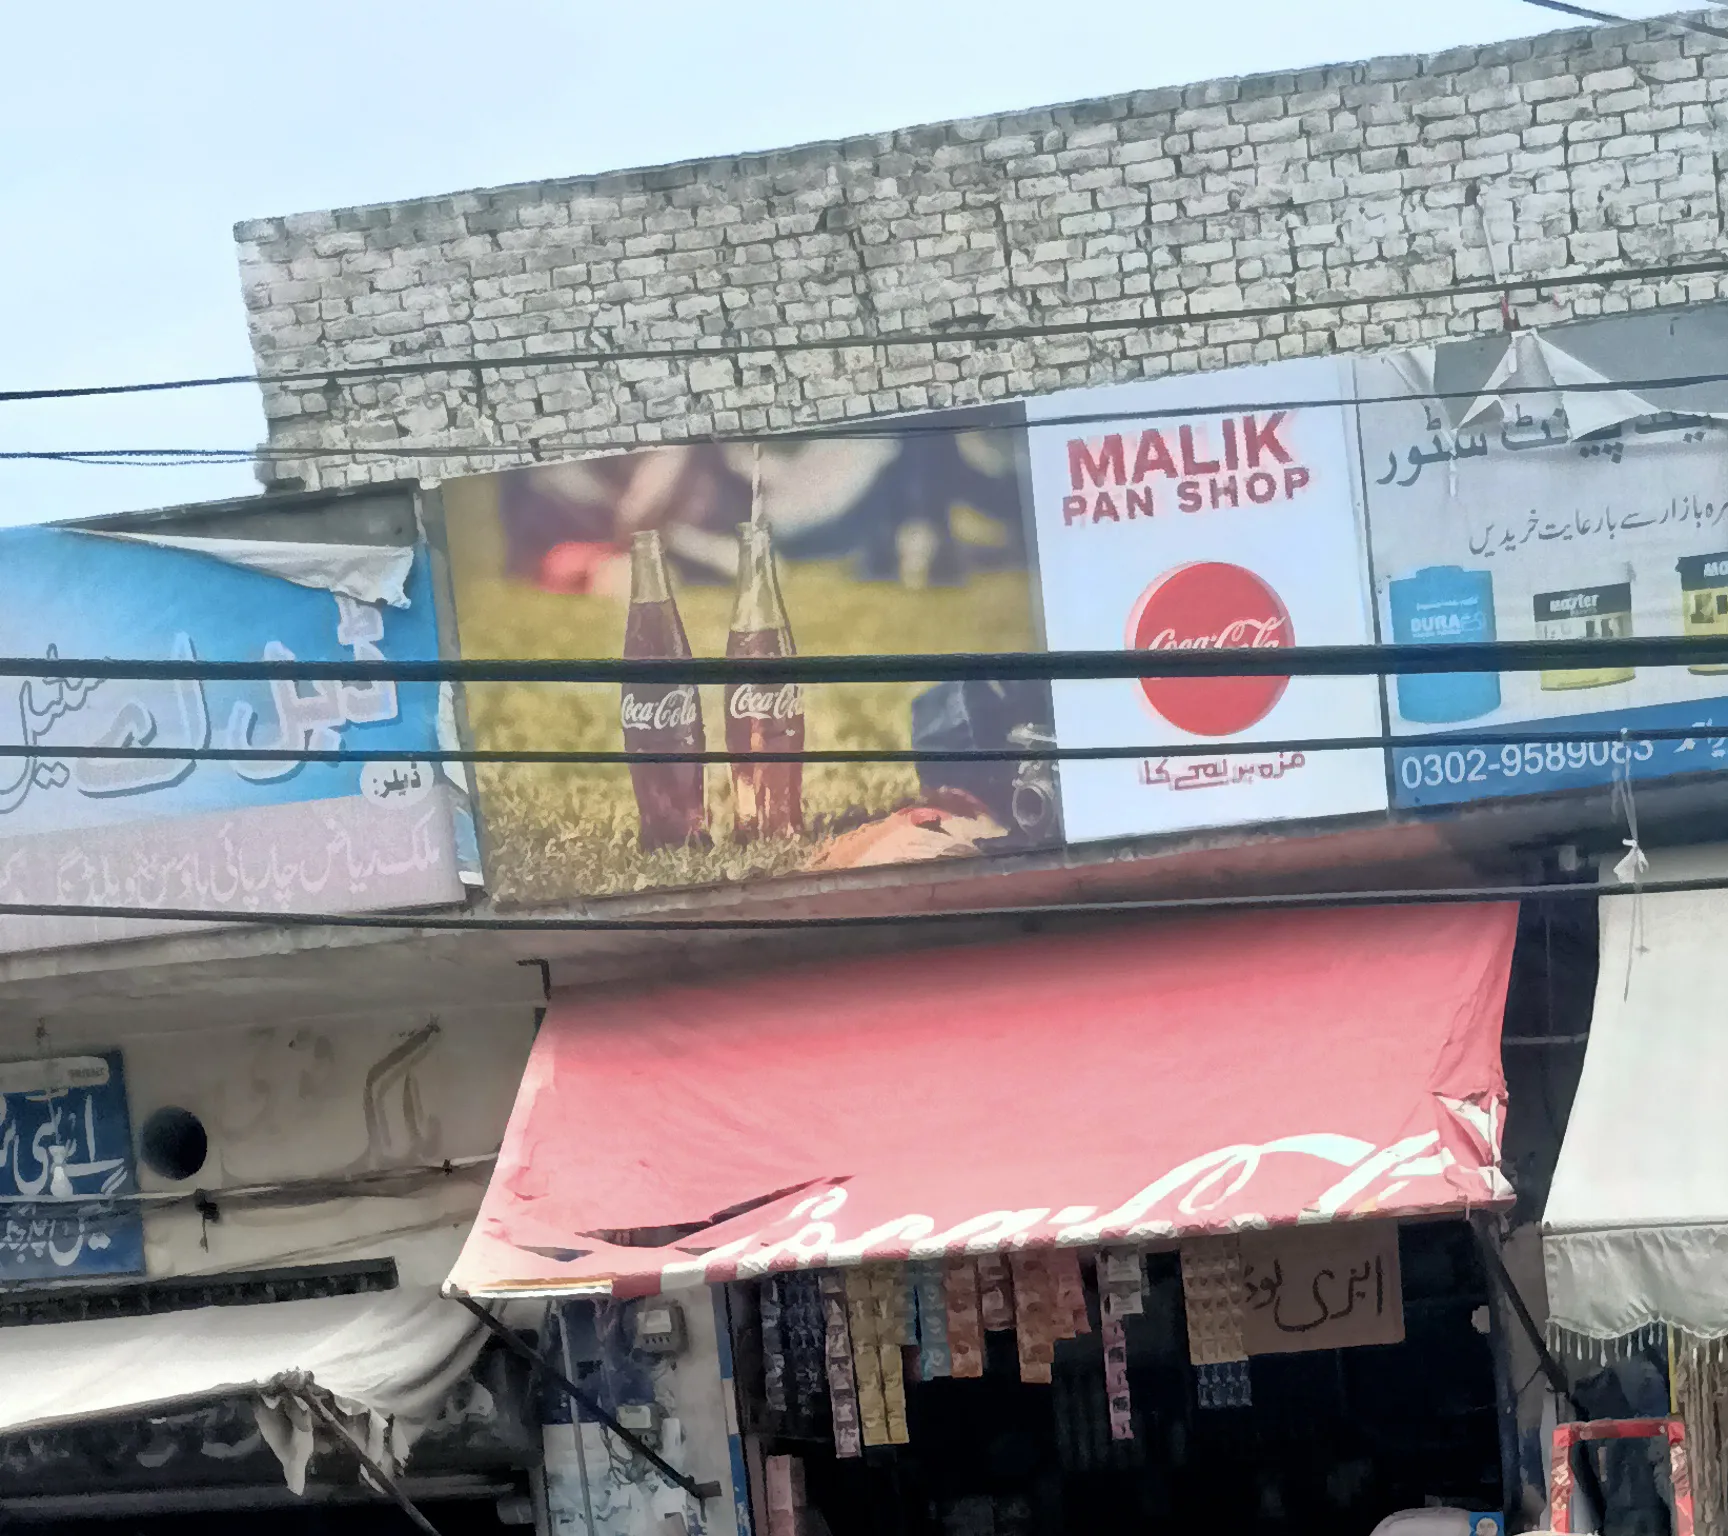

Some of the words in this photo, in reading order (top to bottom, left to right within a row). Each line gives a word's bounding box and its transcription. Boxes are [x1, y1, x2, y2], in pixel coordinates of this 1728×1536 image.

[1066, 411, 1294, 490] MALIK
[1375, 404, 1489, 487] سٹور
[1062, 486, 1155, 526] PAN
[1176, 466, 1310, 513] SHOP
[1620, 512, 1657, 529] سے
[1659, 494, 1704, 528] بازار
[1468, 508, 1541, 558] خریدیں
